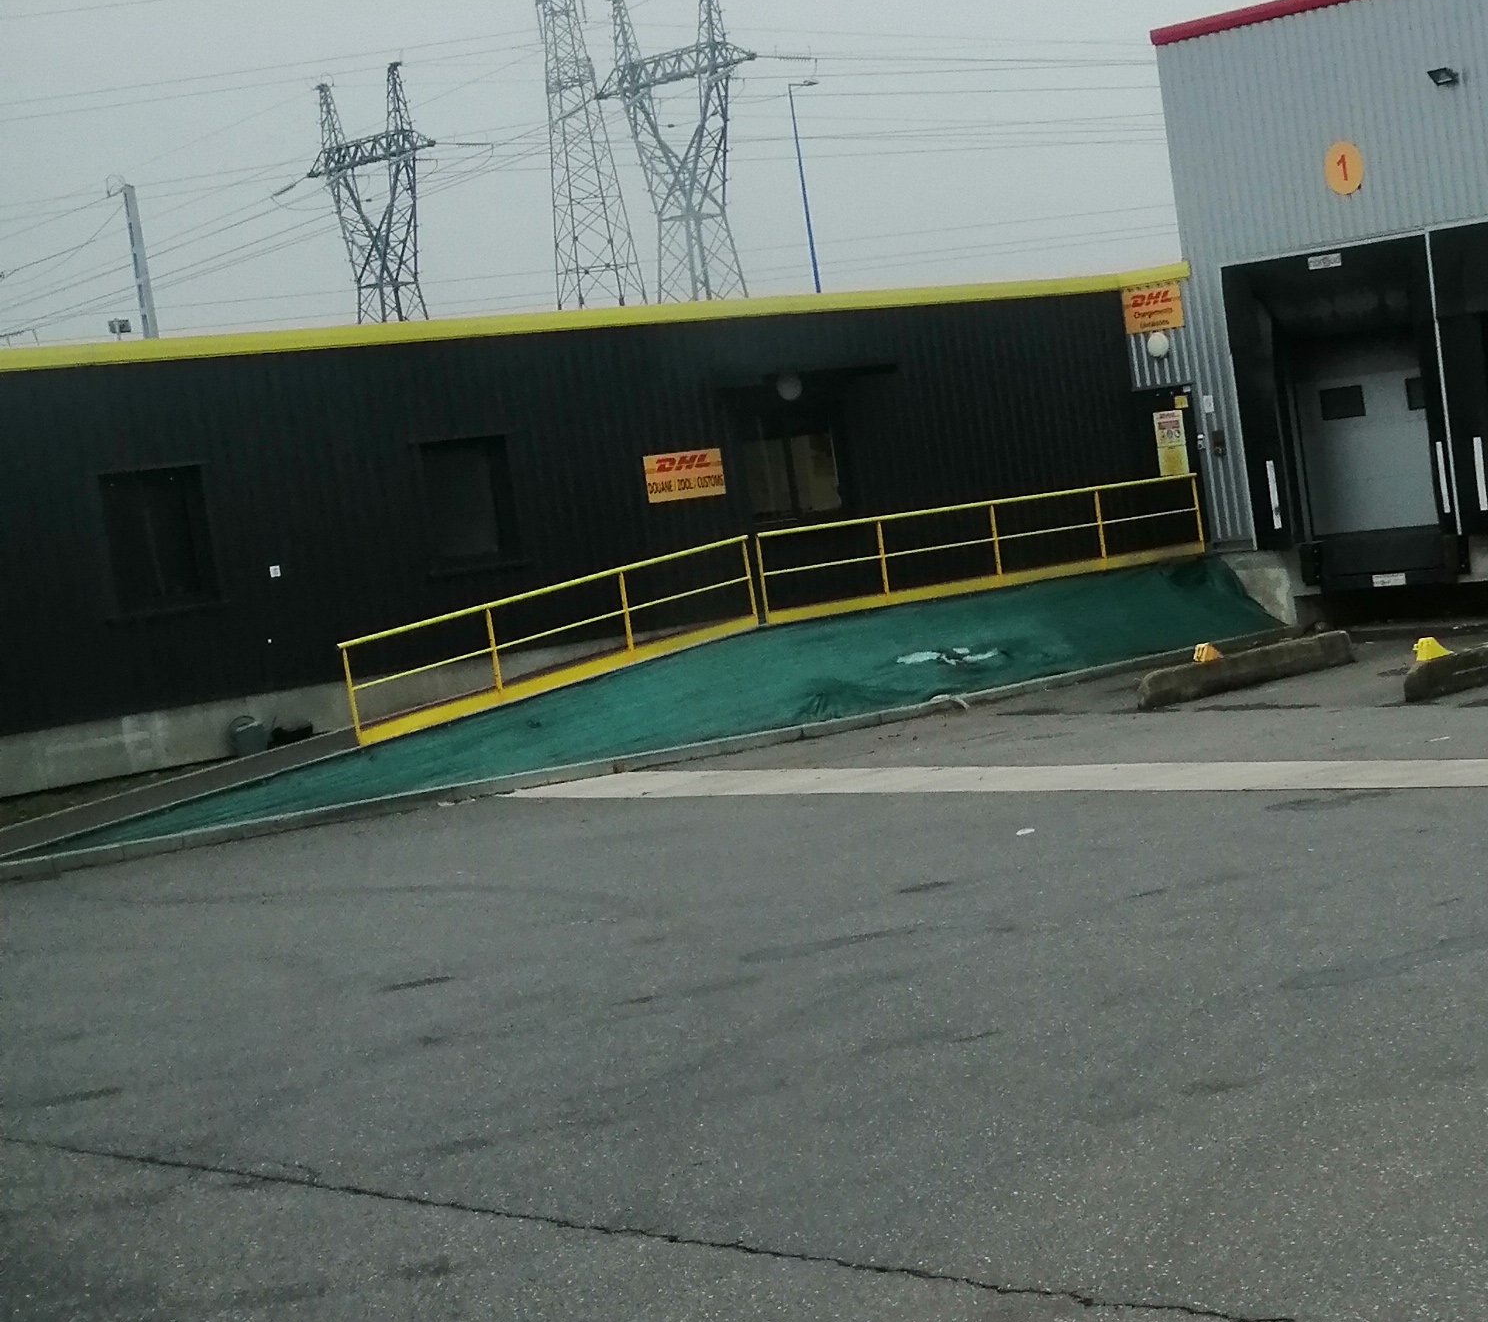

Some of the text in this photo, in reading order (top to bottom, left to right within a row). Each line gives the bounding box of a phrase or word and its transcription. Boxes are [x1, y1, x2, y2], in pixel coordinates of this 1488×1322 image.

[1336, 154, 1349, 182] 1
[1131, 290, 1171, 308] DHL
[656, 453, 711, 472] DHL
[648, 480, 673, 495] DOUANE
[697, 474, 724, 489] CUSTOMS
